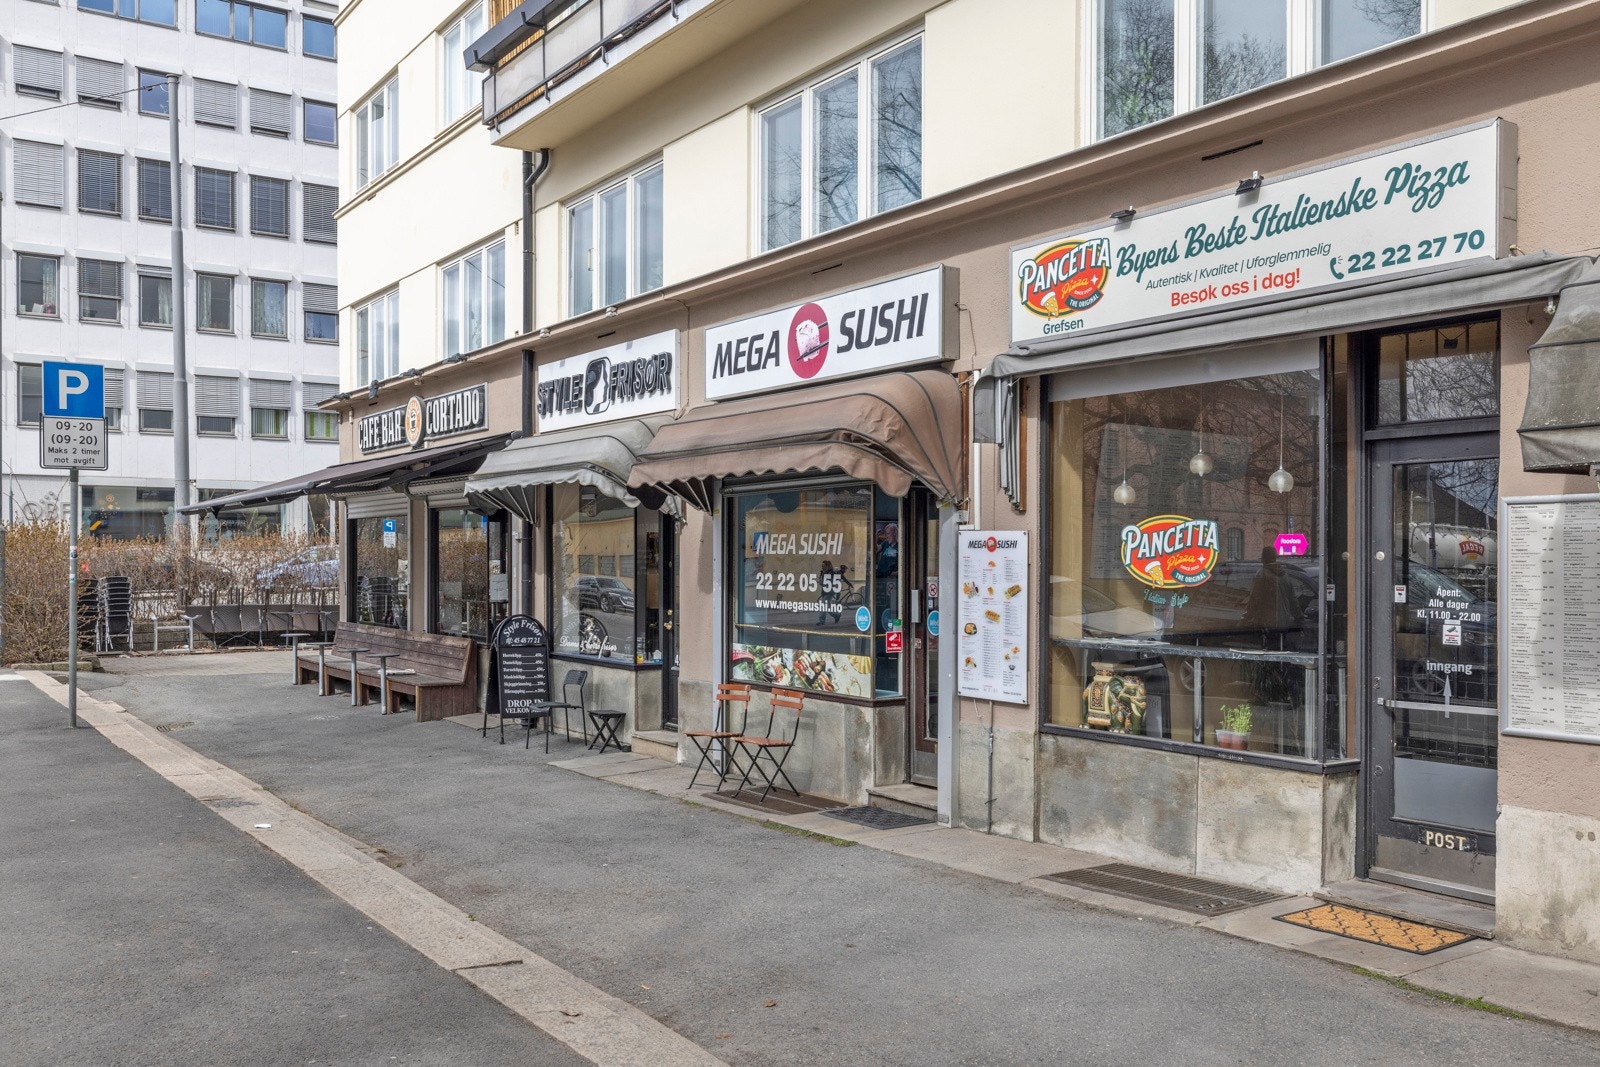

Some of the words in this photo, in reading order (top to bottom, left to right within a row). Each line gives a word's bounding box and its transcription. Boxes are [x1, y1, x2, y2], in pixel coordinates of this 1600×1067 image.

[1116, 240, 1180, 283] Byens
[1184, 215, 1248, 258] Beste
[1250, 177, 1378, 241] Italienske
[1384, 160, 1470, 214] Pizza
[1348, 251, 1376, 274] 22
[1381, 244, 1411, 268] 22
[1417, 236, 1447, 260] 27
[1454, 229, 1485, 254] 70
[1018, 238, 1111, 305] PANCETTA
[1146, 273, 1192, 290] Autentisk
[1199, 262, 1239, 280] Kvalitet
[1246, 242, 1332, 270] Uforglemmelig
[1062, 278, 1090, 300] Pizza
[1171, 283, 1217, 307] Besøk
[1221, 280, 1250, 298] oss
[1253, 274, 1258, 292] i
[1262, 268, 1300, 290] dag!
[1070, 298, 1078, 308] THE
[1078, 294, 1099, 308] ORIGINAL
[1043, 318, 1084, 334] Grefsen
[712, 330, 780, 380] MEGA
[836, 292, 929, 354] SUSHI
[58, 369, 90, 410] P
[537, 374, 584, 418] STYLE
[608, 351, 672, 403] FRISØR
[359, 415, 380, 448] CAFE
[381, 410, 402, 444] BAR
[426, 388, 480, 434] CORTADO
[81, 448, 100, 456] timer
[756, 532, 796, 555] MEGA
[799, 532, 843, 555] SUSHI
[968, 540, 987, 548] MEGA
[996, 540, 1018, 548] SUSHI
[1121, 520, 1220, 566] PANCETTA
[1166, 554, 1196, 570] Pizza
[756, 572, 772, 590] 22
[777, 572, 794, 591] 22
[800, 574, 818, 592] 05
[822, 574, 842, 593] 55
[1175, 572, 1185, 582] THE
[1185, 573, 1206, 583] ORIGINAL
[1436, 586, 1462, 597] Åpent:
[755, 599, 843, 613] www.megasushi.no
[1428, 599, 1444, 608] Alle
[1446, 600, 1469, 610] dager
[1417, 610, 1427, 618] Kl.
[1430, 610, 1450, 620] 11.00
[1458, 612, 1481, 621] 22.00
[503, 621, 520, 637] Style
[521, 619, 542, 637] Frisør
[1426, 660, 1473, 675] inngang
[507, 699, 532, 707] DROP
[1426, 831, 1466, 850] POST
